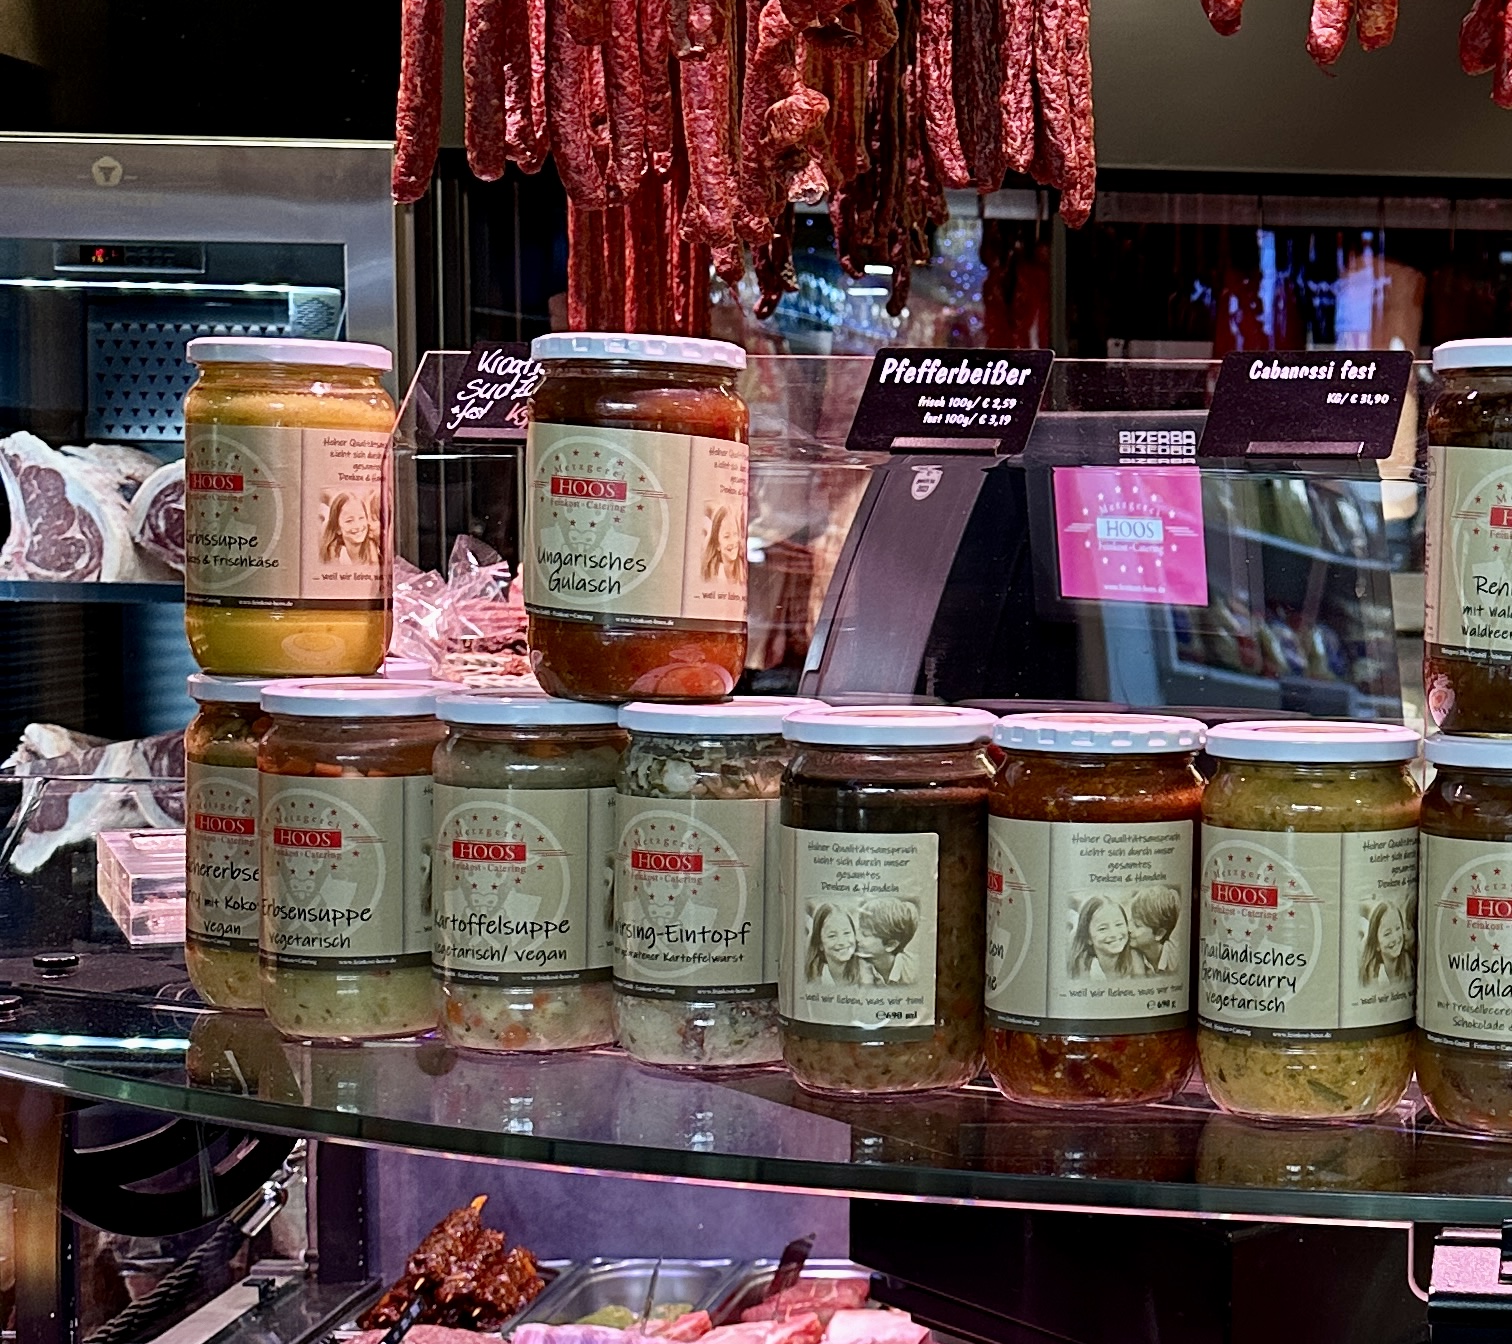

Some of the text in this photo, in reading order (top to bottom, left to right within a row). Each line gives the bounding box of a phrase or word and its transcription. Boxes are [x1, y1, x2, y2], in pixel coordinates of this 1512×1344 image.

[879, 357, 1032, 385] Pfefferbeißer
[1249, 359, 1377, 380] Cabanossi fest
[988, 414, 1012, 427] 3,19
[1119, 431, 1196, 444] BIZERBA
[559, 479, 617, 499] HOOS
[1106, 520, 1155, 538] HOOS
[213, 555, 280, 568] Frischkäse
[537, 545, 647, 573] Ungarisches
[549, 570, 621, 594] Gulasch
[1462, 604, 1485, 616] mit
[199, 815, 246, 833] HOOS
[280, 831, 332, 846] HOOS
[460, 844, 515, 861] HOOS
[638, 853, 692, 871] HOOS
[1217, 884, 1268, 905] HOOS
[262, 898, 372, 926] Erbsensuppe
[203, 919, 241, 937] vegan
[434, 909, 570, 941] Kartoffelsuppe
[269, 933, 350, 949] vegetarisch
[515, 948, 567, 967] vegan
[1200, 937, 1307, 967] Thailändisches
[1201, 960, 1297, 994] Gemüsecurry
[1205, 990, 1286, 1013] vegetarisch
[1452, 1016, 1505, 1032] Schokolade
